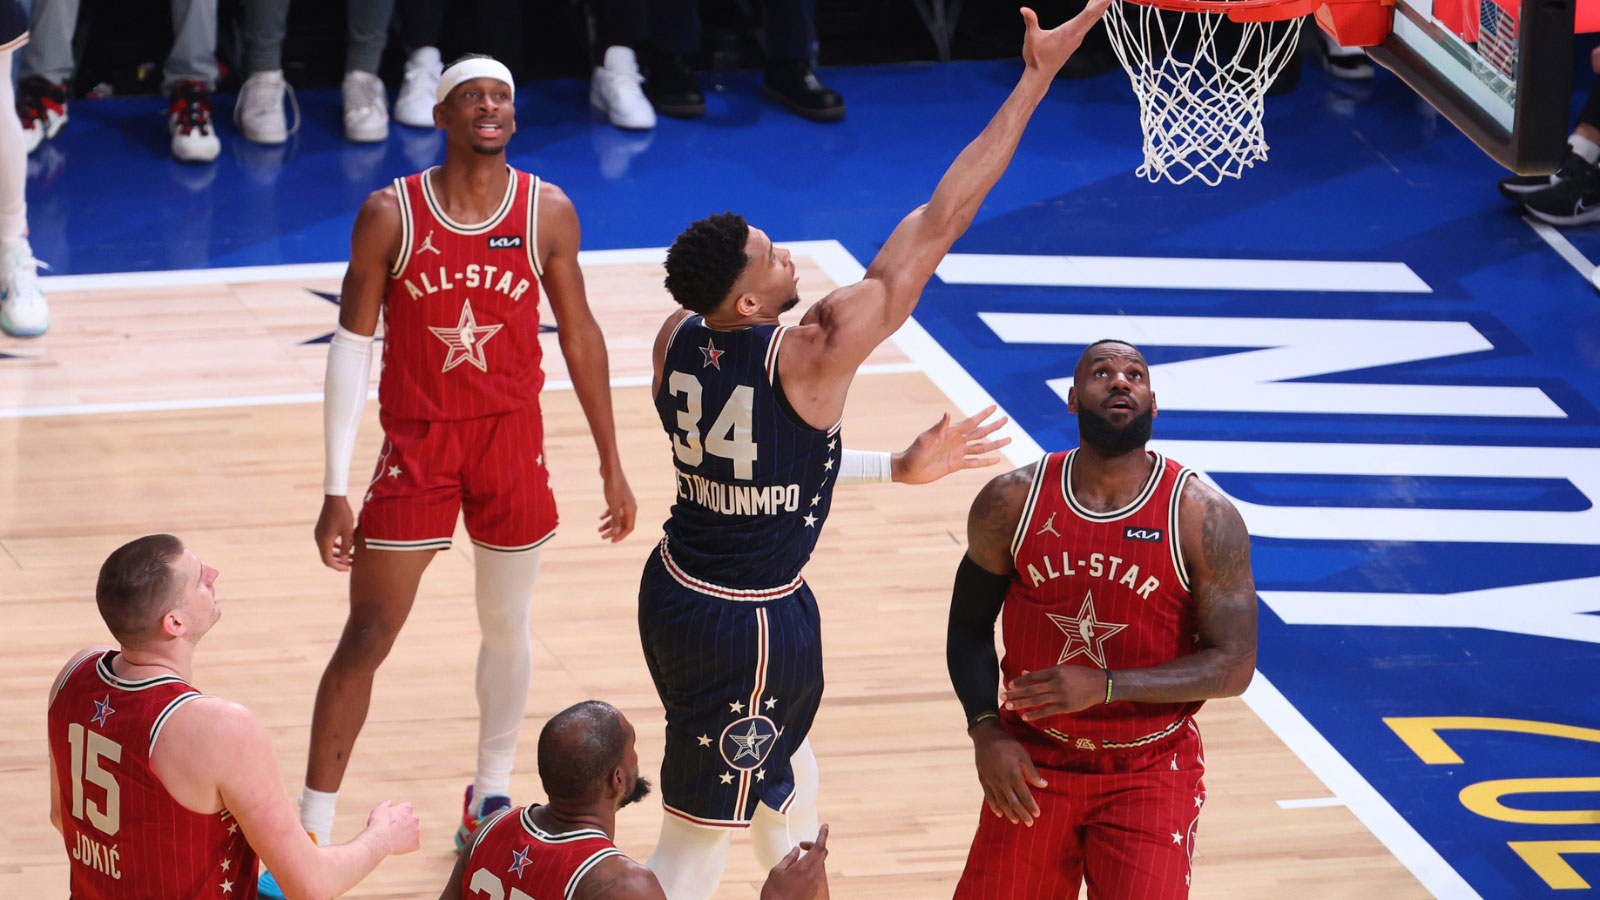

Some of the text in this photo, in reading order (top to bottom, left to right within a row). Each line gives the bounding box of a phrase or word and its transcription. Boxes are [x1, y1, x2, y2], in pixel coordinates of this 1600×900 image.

[404, 264, 530, 301] ALL-STAR
[668, 370, 758, 481] 34
[1027, 551, 1160, 600] ALL-STAR
[67, 722, 122, 837] 15
[72, 830, 122, 880] JOKIĆ
